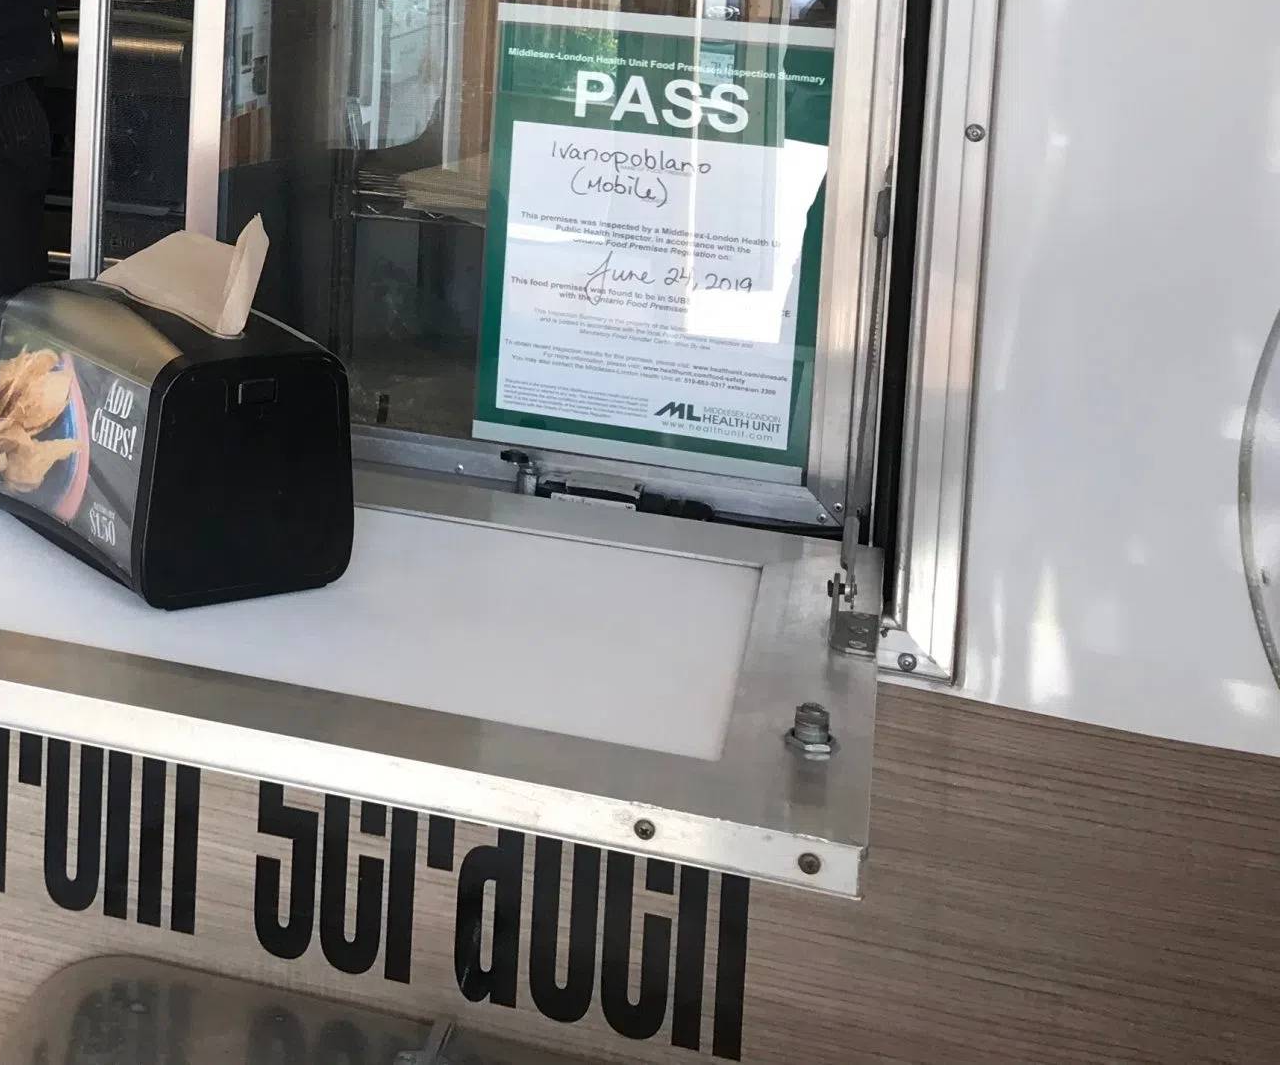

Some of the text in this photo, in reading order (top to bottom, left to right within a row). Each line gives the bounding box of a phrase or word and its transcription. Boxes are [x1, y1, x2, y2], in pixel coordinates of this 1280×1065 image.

[508, 47, 594, 63] Middlesex-London
[596, 55, 626, 67] Health
[628, 58, 648, 68] Unit
[650, 60, 676, 71] Food
[778, 70, 826, 86] Summary
[574, 70, 750, 134] PASS
[521, 211, 538, 220] This
[540, 214, 578, 224] premises
[600, 220, 640, 232] inspected
[642, 224, 652, 234] by
[584, 228, 610, 237] Health
[718, 244, 735, 252] with
[738, 246, 751, 254] the
[606, 240, 627, 249] Food
[628, 242, 668, 254] Premises
[511, 276, 528, 285] This
[530, 278, 548, 288] food
[608, 288, 632, 298] found
[705, 273, 752, 293] 2019
[104, 379, 134, 420] ADD
[654, 402, 701, 422] ML
[91, 407, 137, 460] CHIPS!
[702, 414, 781, 434] HEALTH UNIT
